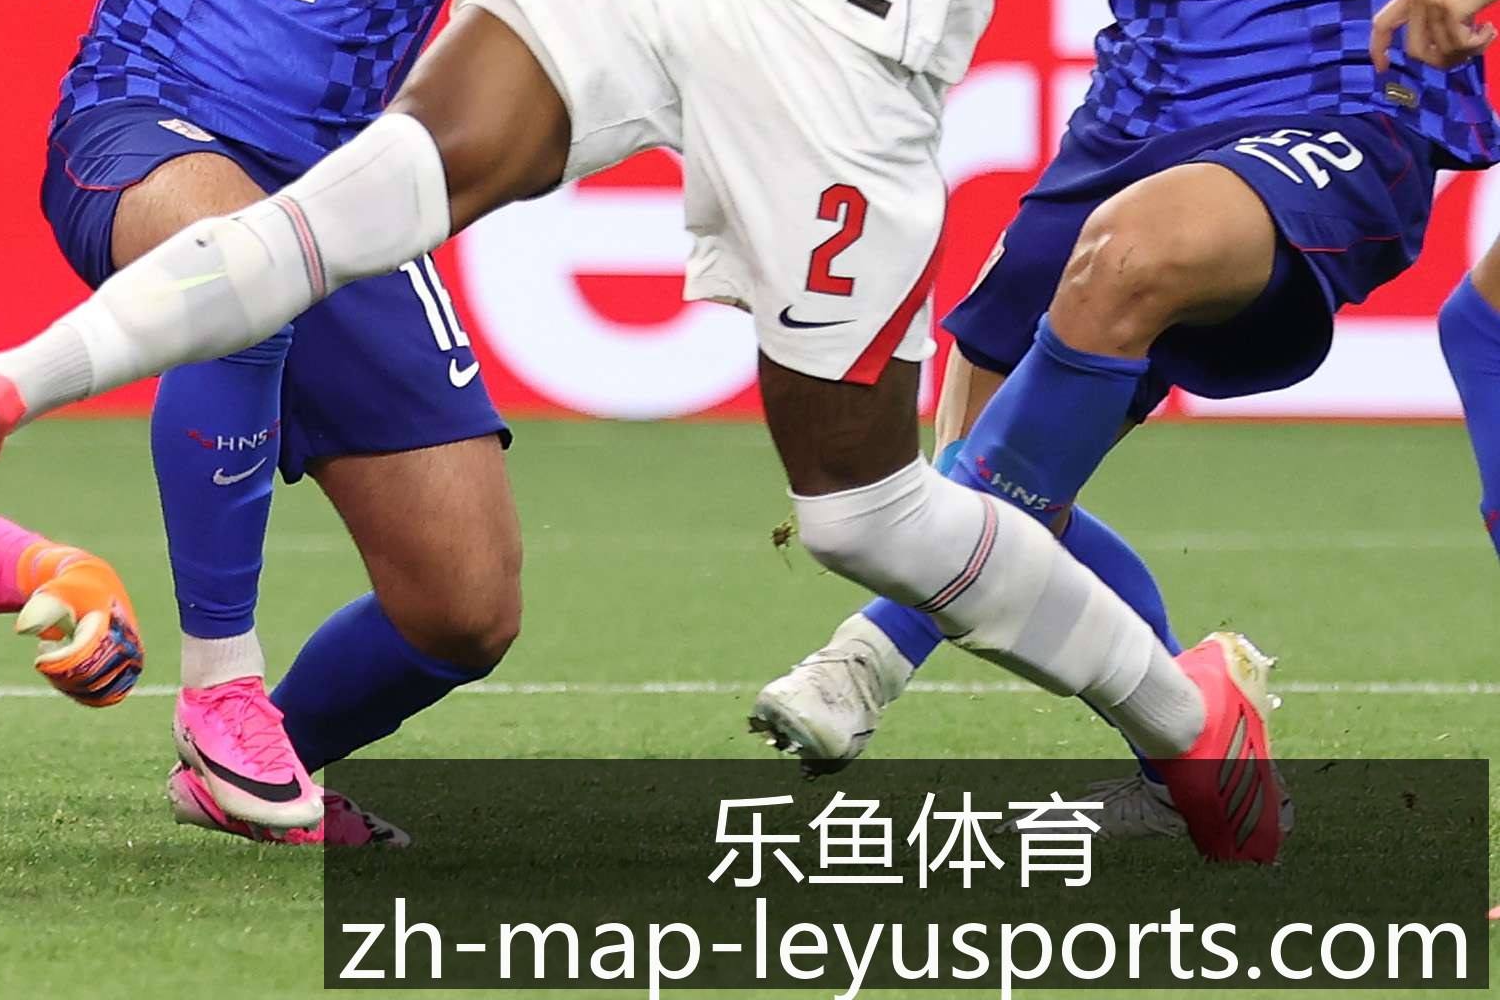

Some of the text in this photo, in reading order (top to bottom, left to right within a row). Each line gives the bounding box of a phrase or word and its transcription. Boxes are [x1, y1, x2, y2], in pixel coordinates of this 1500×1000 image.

[805, 183, 869, 297] 2
[217, 428, 268, 451] HNS
[991, 472, 1051, 511] HNS
